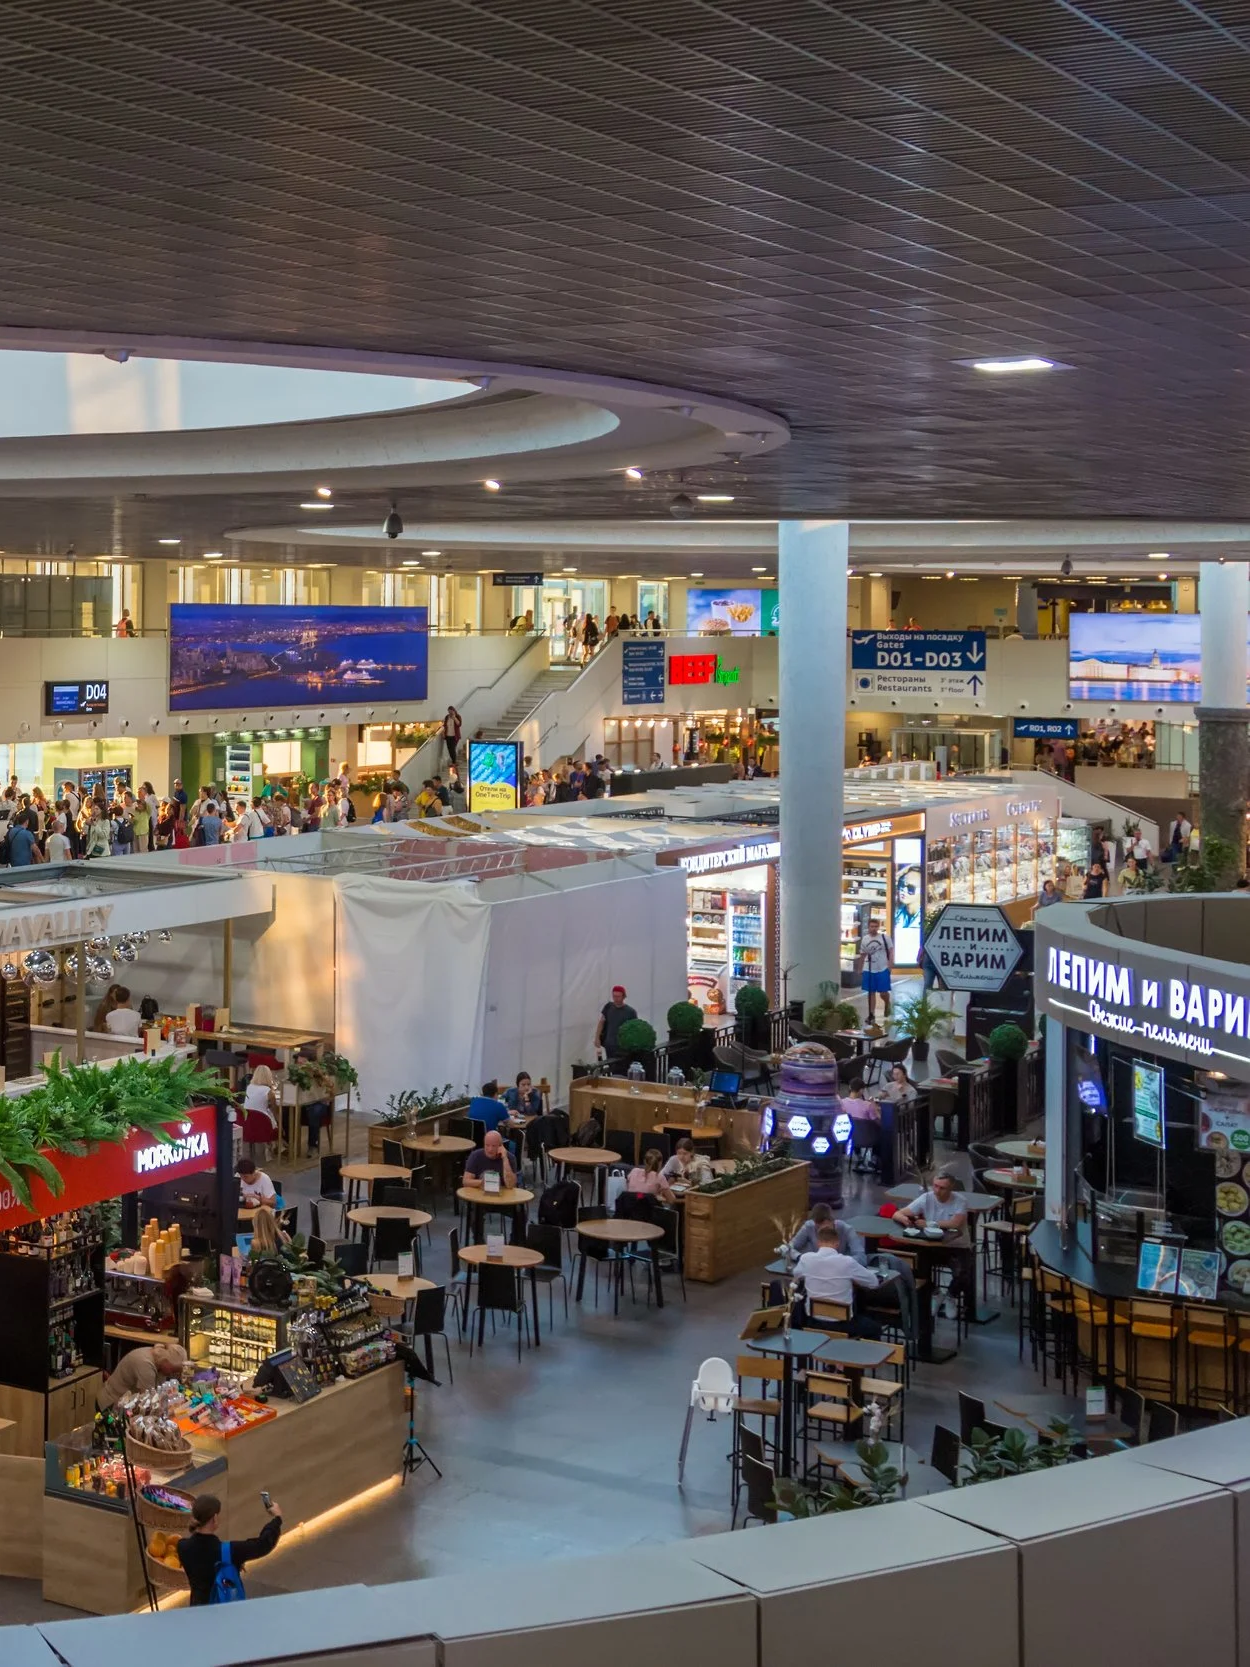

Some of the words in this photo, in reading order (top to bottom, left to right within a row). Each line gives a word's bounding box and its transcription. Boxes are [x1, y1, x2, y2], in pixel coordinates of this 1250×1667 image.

[877, 633, 912, 641] Выходы
[926, 634, 964, 642] посадку
[877, 641, 904, 649] Gates
[877, 651, 962, 667] D01-D03
[877, 675, 926, 683] Рестораны
[86, 684, 107, 700] D04
[877, 684, 932, 692] Restaurants
[475, 791, 511, 800] OneTwoTrip
[939, 926, 1008, 943] ЛЕПИМ
[940, 951, 1007, 970] ВАРИМ
[1048, 946, 1131, 1007] ЛЕПИМ
[1169, 979, 1250, 1039] ВАРИ
[1089, 999, 1136, 1034] Свежие
[1143, 1021, 1214, 1056] пельмени
[137, 1132, 209, 1173] MORKOVKA
